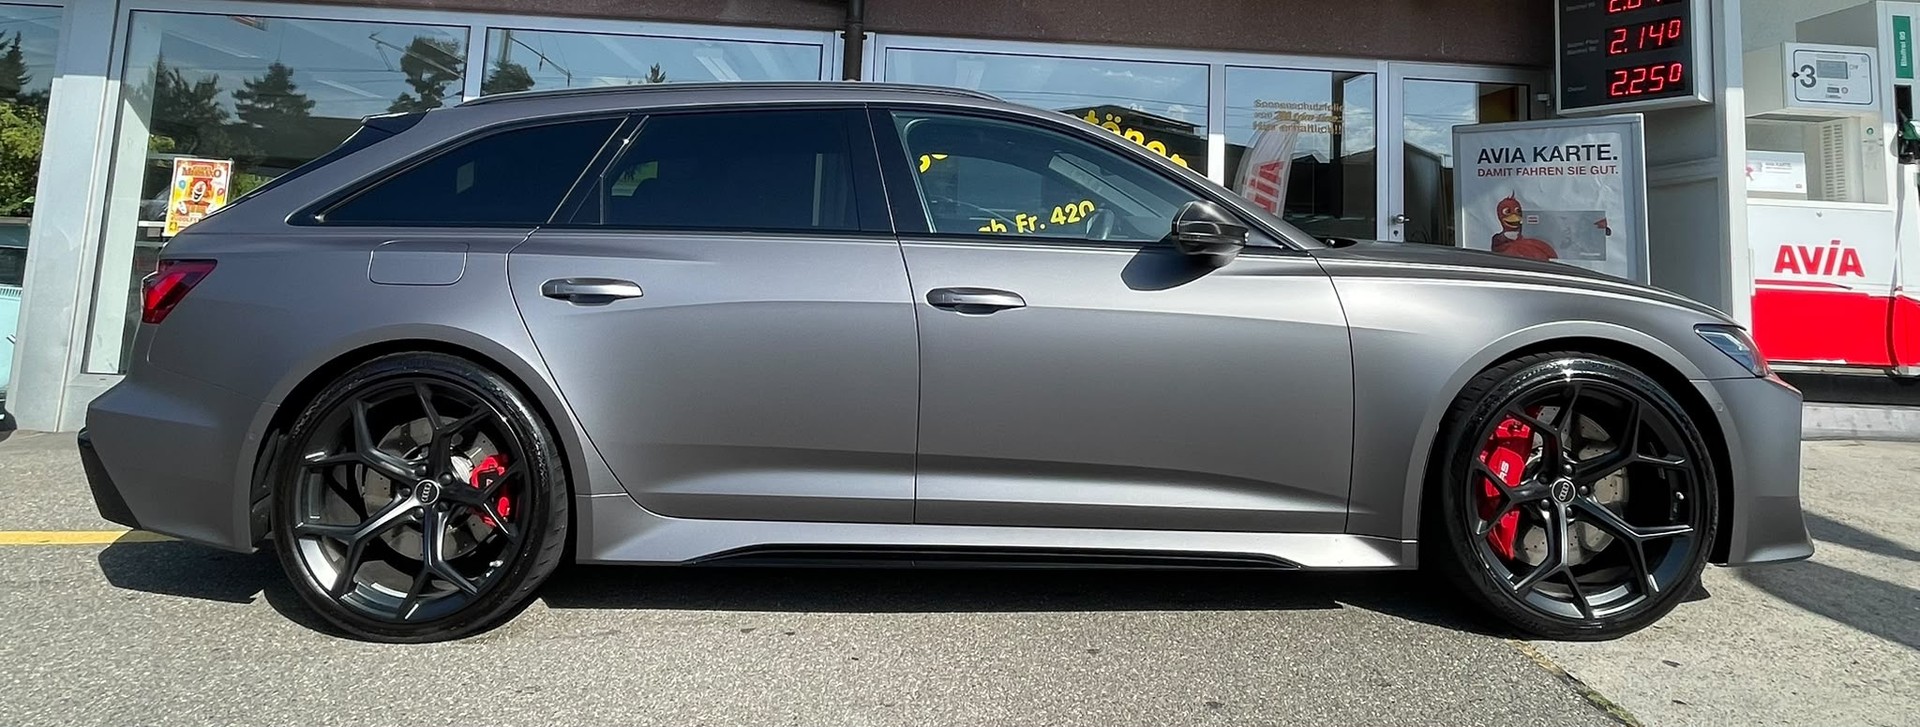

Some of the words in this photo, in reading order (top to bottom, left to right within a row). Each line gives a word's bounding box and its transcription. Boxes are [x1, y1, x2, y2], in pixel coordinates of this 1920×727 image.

[1610, 19, 1682, 55] 2.140
[1611, 62, 1683, 96] 2.250
[1799, 64, 1817, 89] 3
[1477, 147, 1526, 165] AVIA
[1533, 143, 1618, 163] KARTE.
[1477, 167, 1514, 177] DAMIT
[1516, 166, 1563, 177] FAHREN
[1567, 165, 1586, 176] SIE
[1590, 165, 1619, 176] GUT.
[1015, 213, 1046, 234] Fr.
[1773, 239, 1865, 278] AVIA
